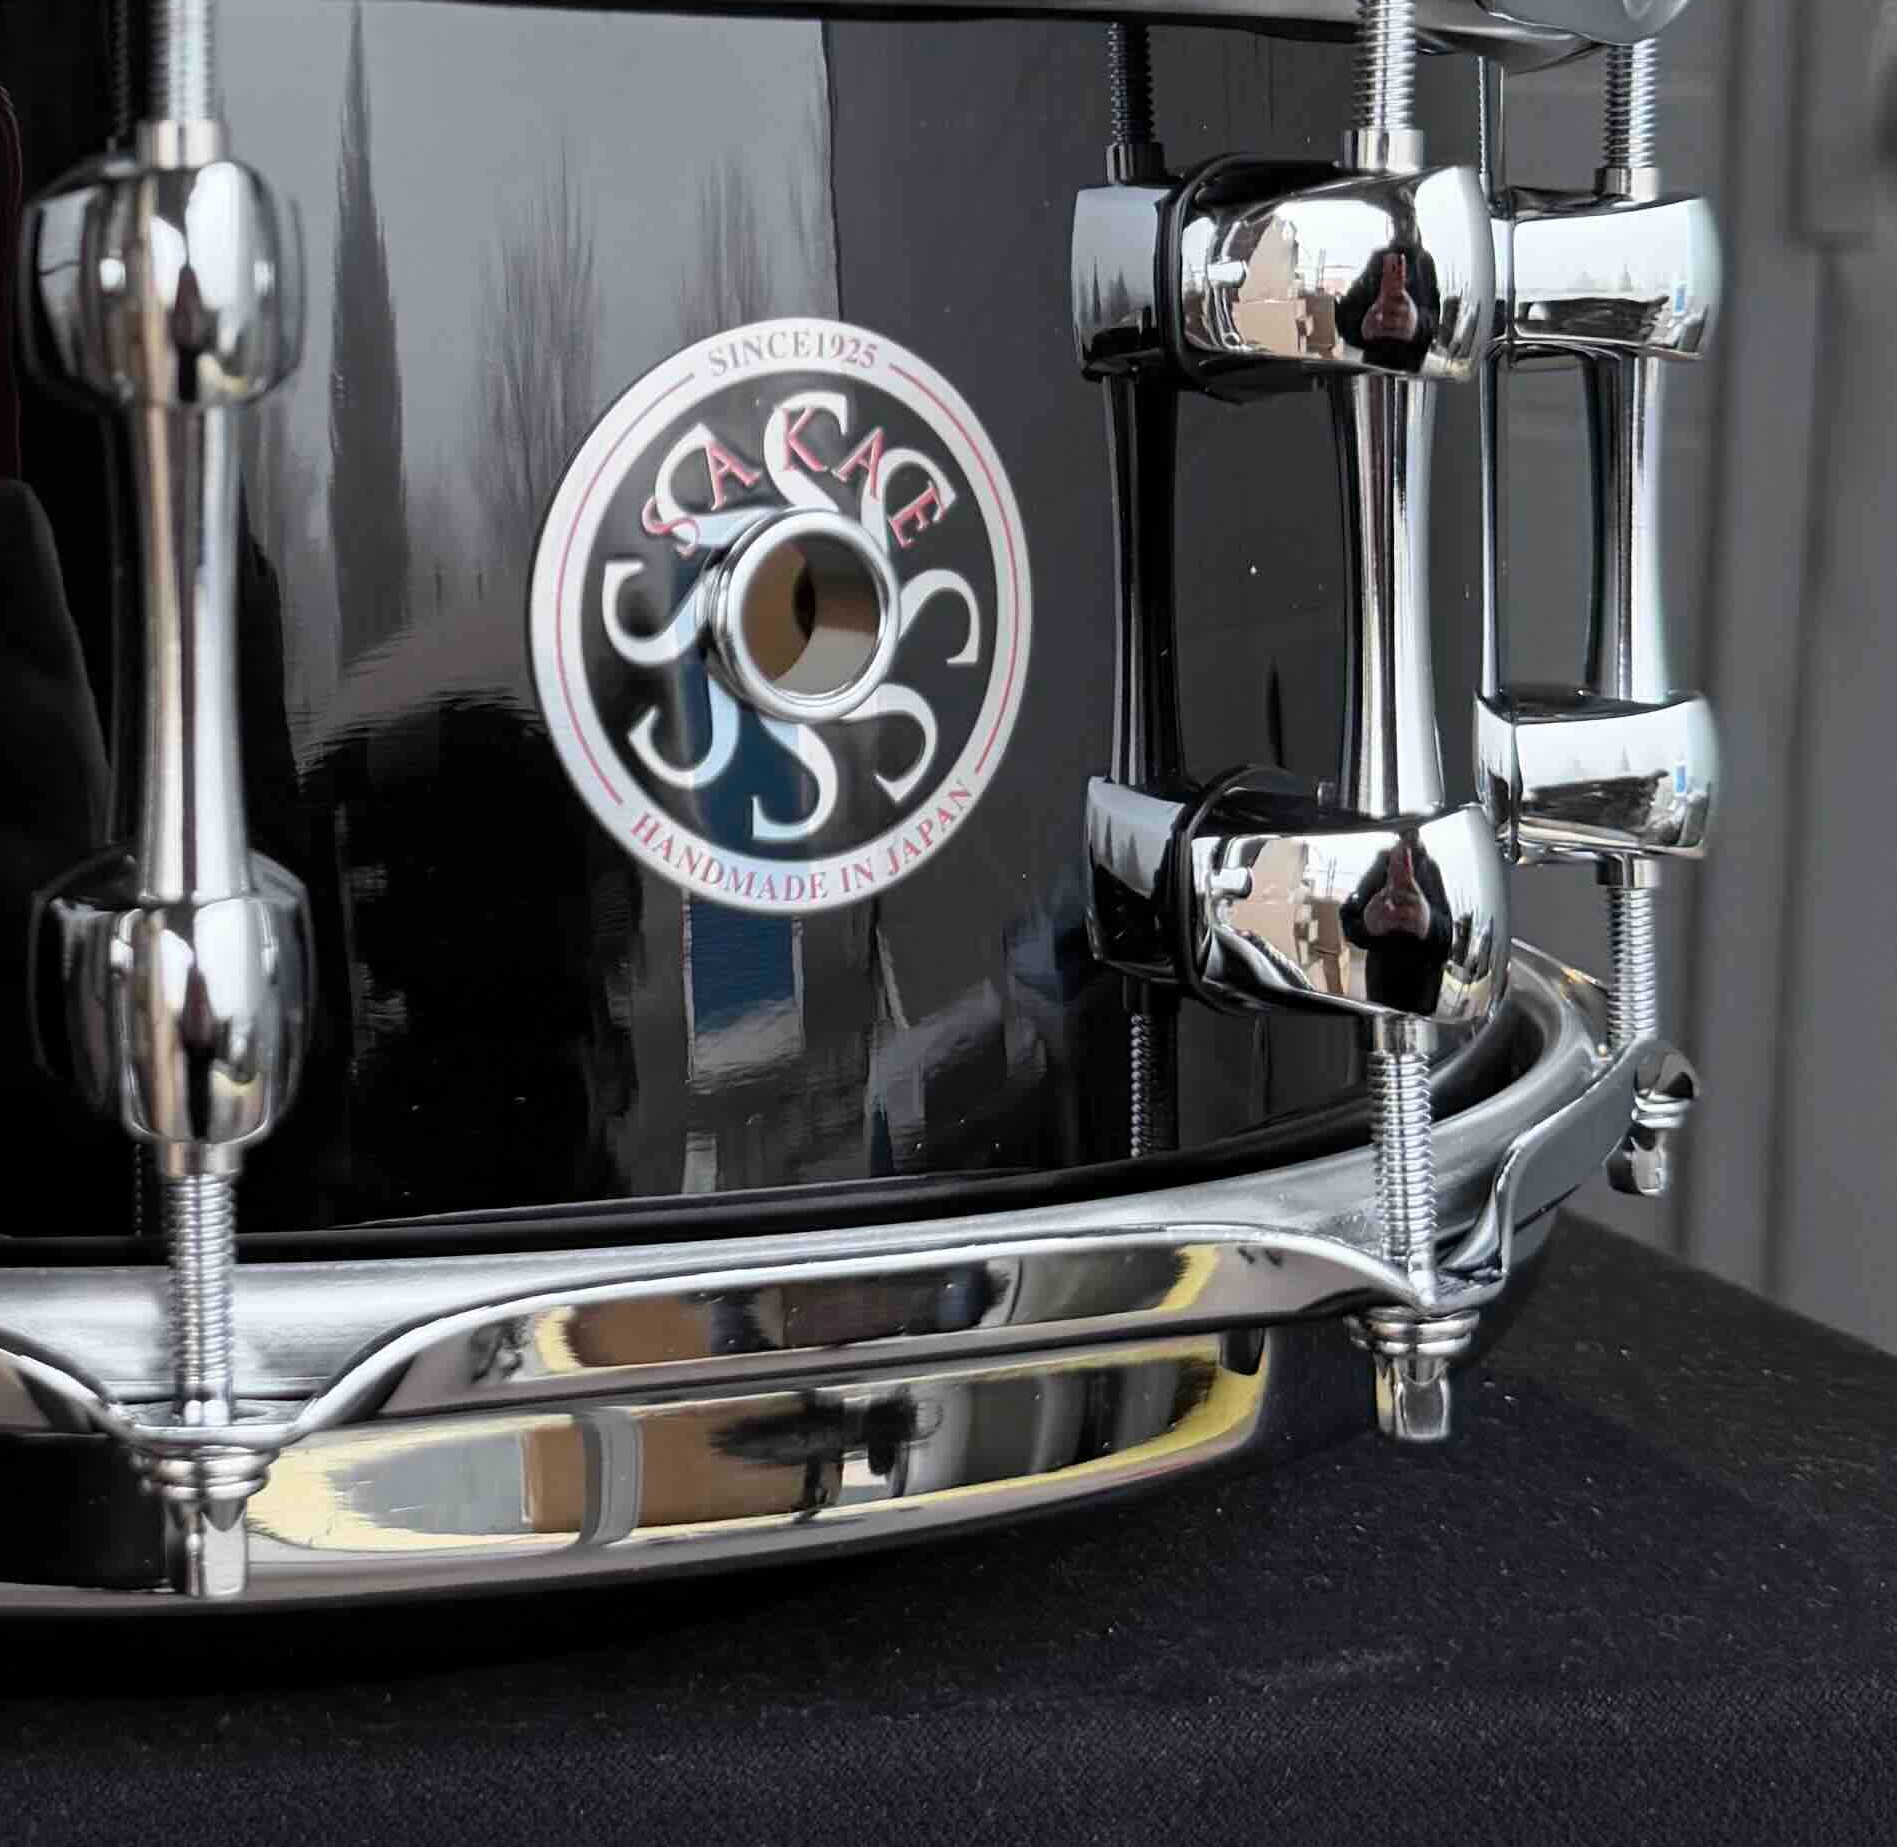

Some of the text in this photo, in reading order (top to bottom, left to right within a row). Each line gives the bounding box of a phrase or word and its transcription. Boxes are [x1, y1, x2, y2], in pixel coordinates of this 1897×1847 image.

[641, 405, 951, 559] SAKAE
[630, 780, 973, 902] HANDMADE IN JAPAN
